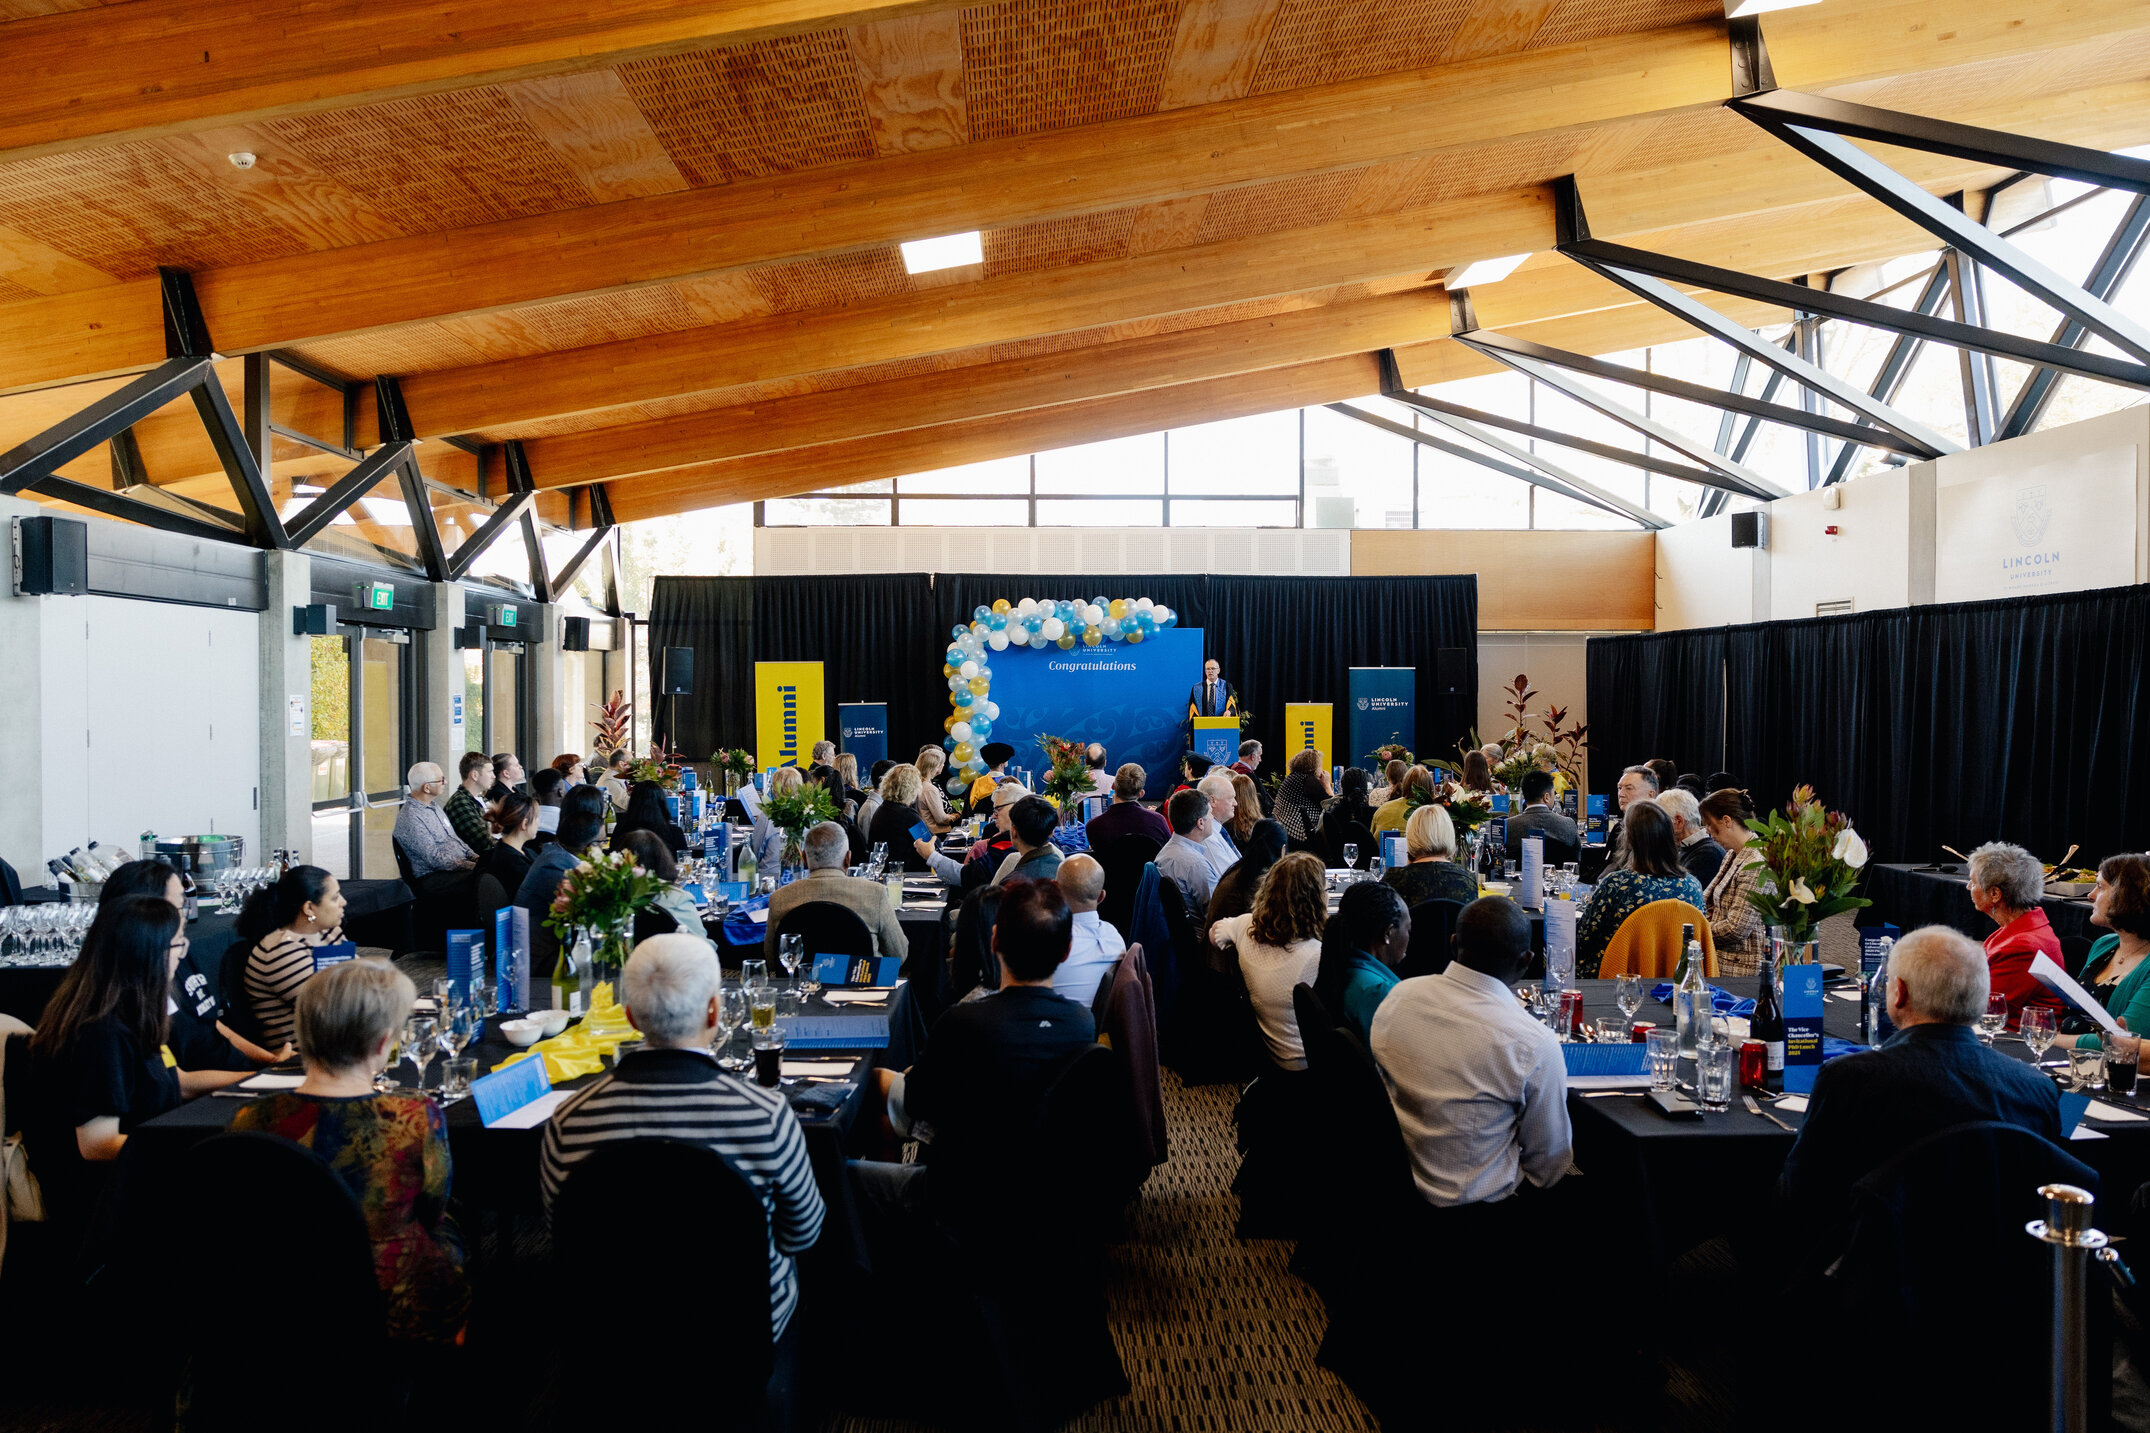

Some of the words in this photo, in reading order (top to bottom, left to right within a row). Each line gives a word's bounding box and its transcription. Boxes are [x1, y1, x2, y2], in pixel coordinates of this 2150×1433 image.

[2002, 551, 2060, 569] LINCOLN
[2010, 569, 2052, 580] UNIVERSITY
[376, 591, 389, 606] EXIT
[505, 612, 515, 623] EXIT
[1048, 660, 1137, 673] Congratulations
